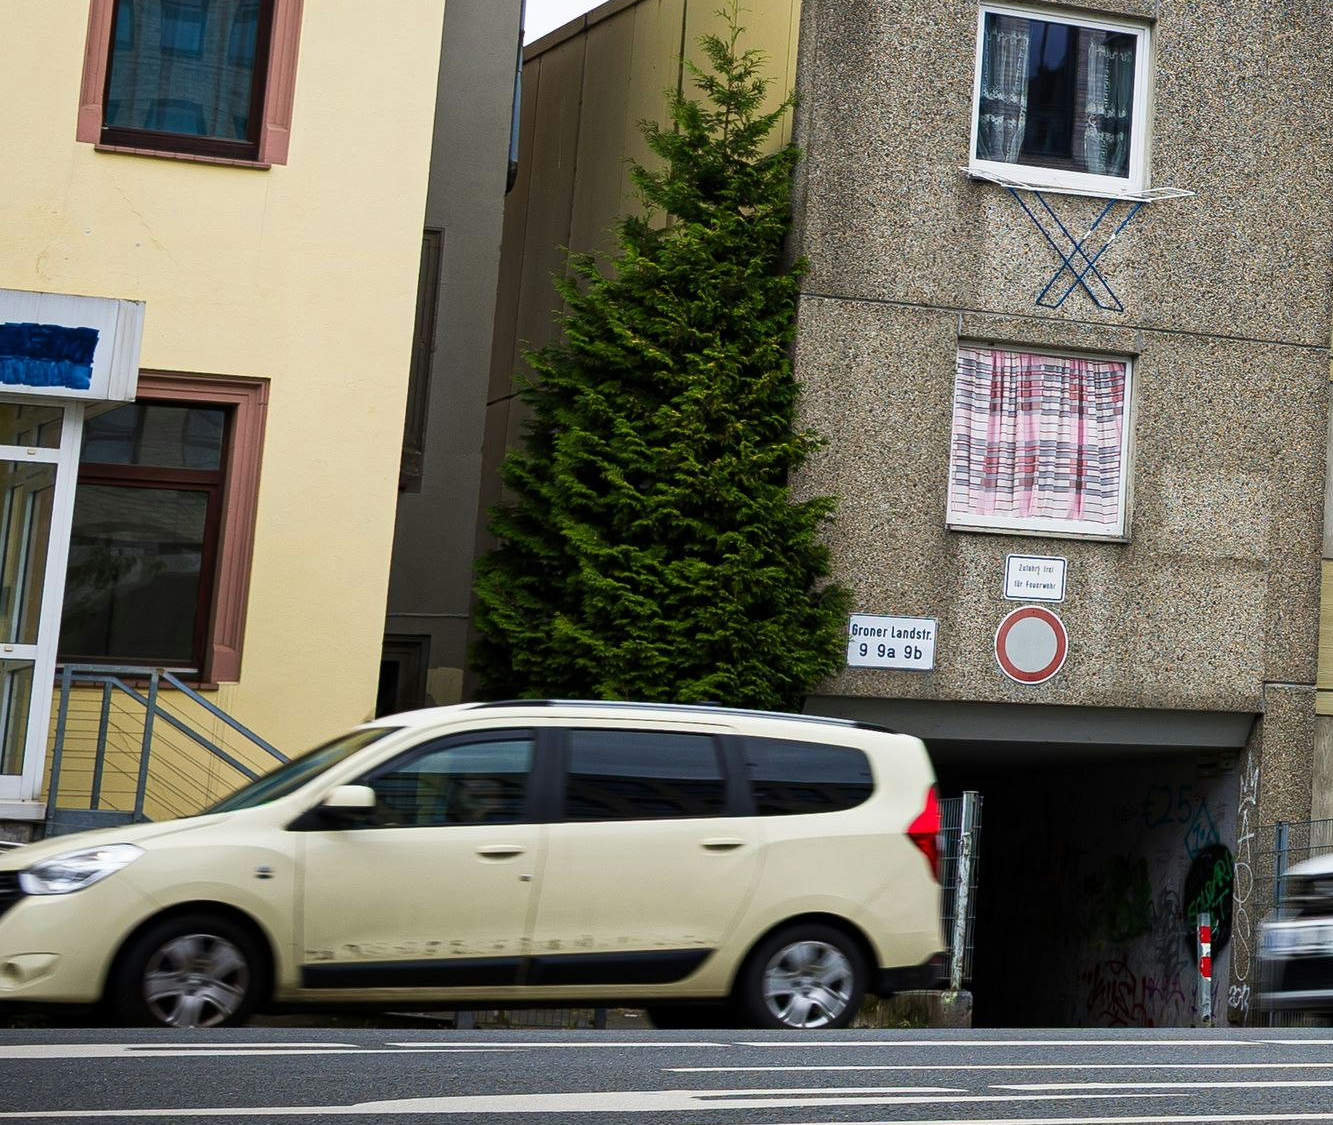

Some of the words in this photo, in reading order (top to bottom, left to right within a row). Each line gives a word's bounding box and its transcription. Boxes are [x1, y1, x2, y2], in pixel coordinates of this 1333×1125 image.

[1025, 580, 1056, 590] Feuerwehr
[852, 624, 888, 637] Groner
[891, 626, 932, 640] Landstr.
[859, 643, 868, 657] 9
[877, 644, 896, 658] 9a
[904, 645, 923, 660] 9b
